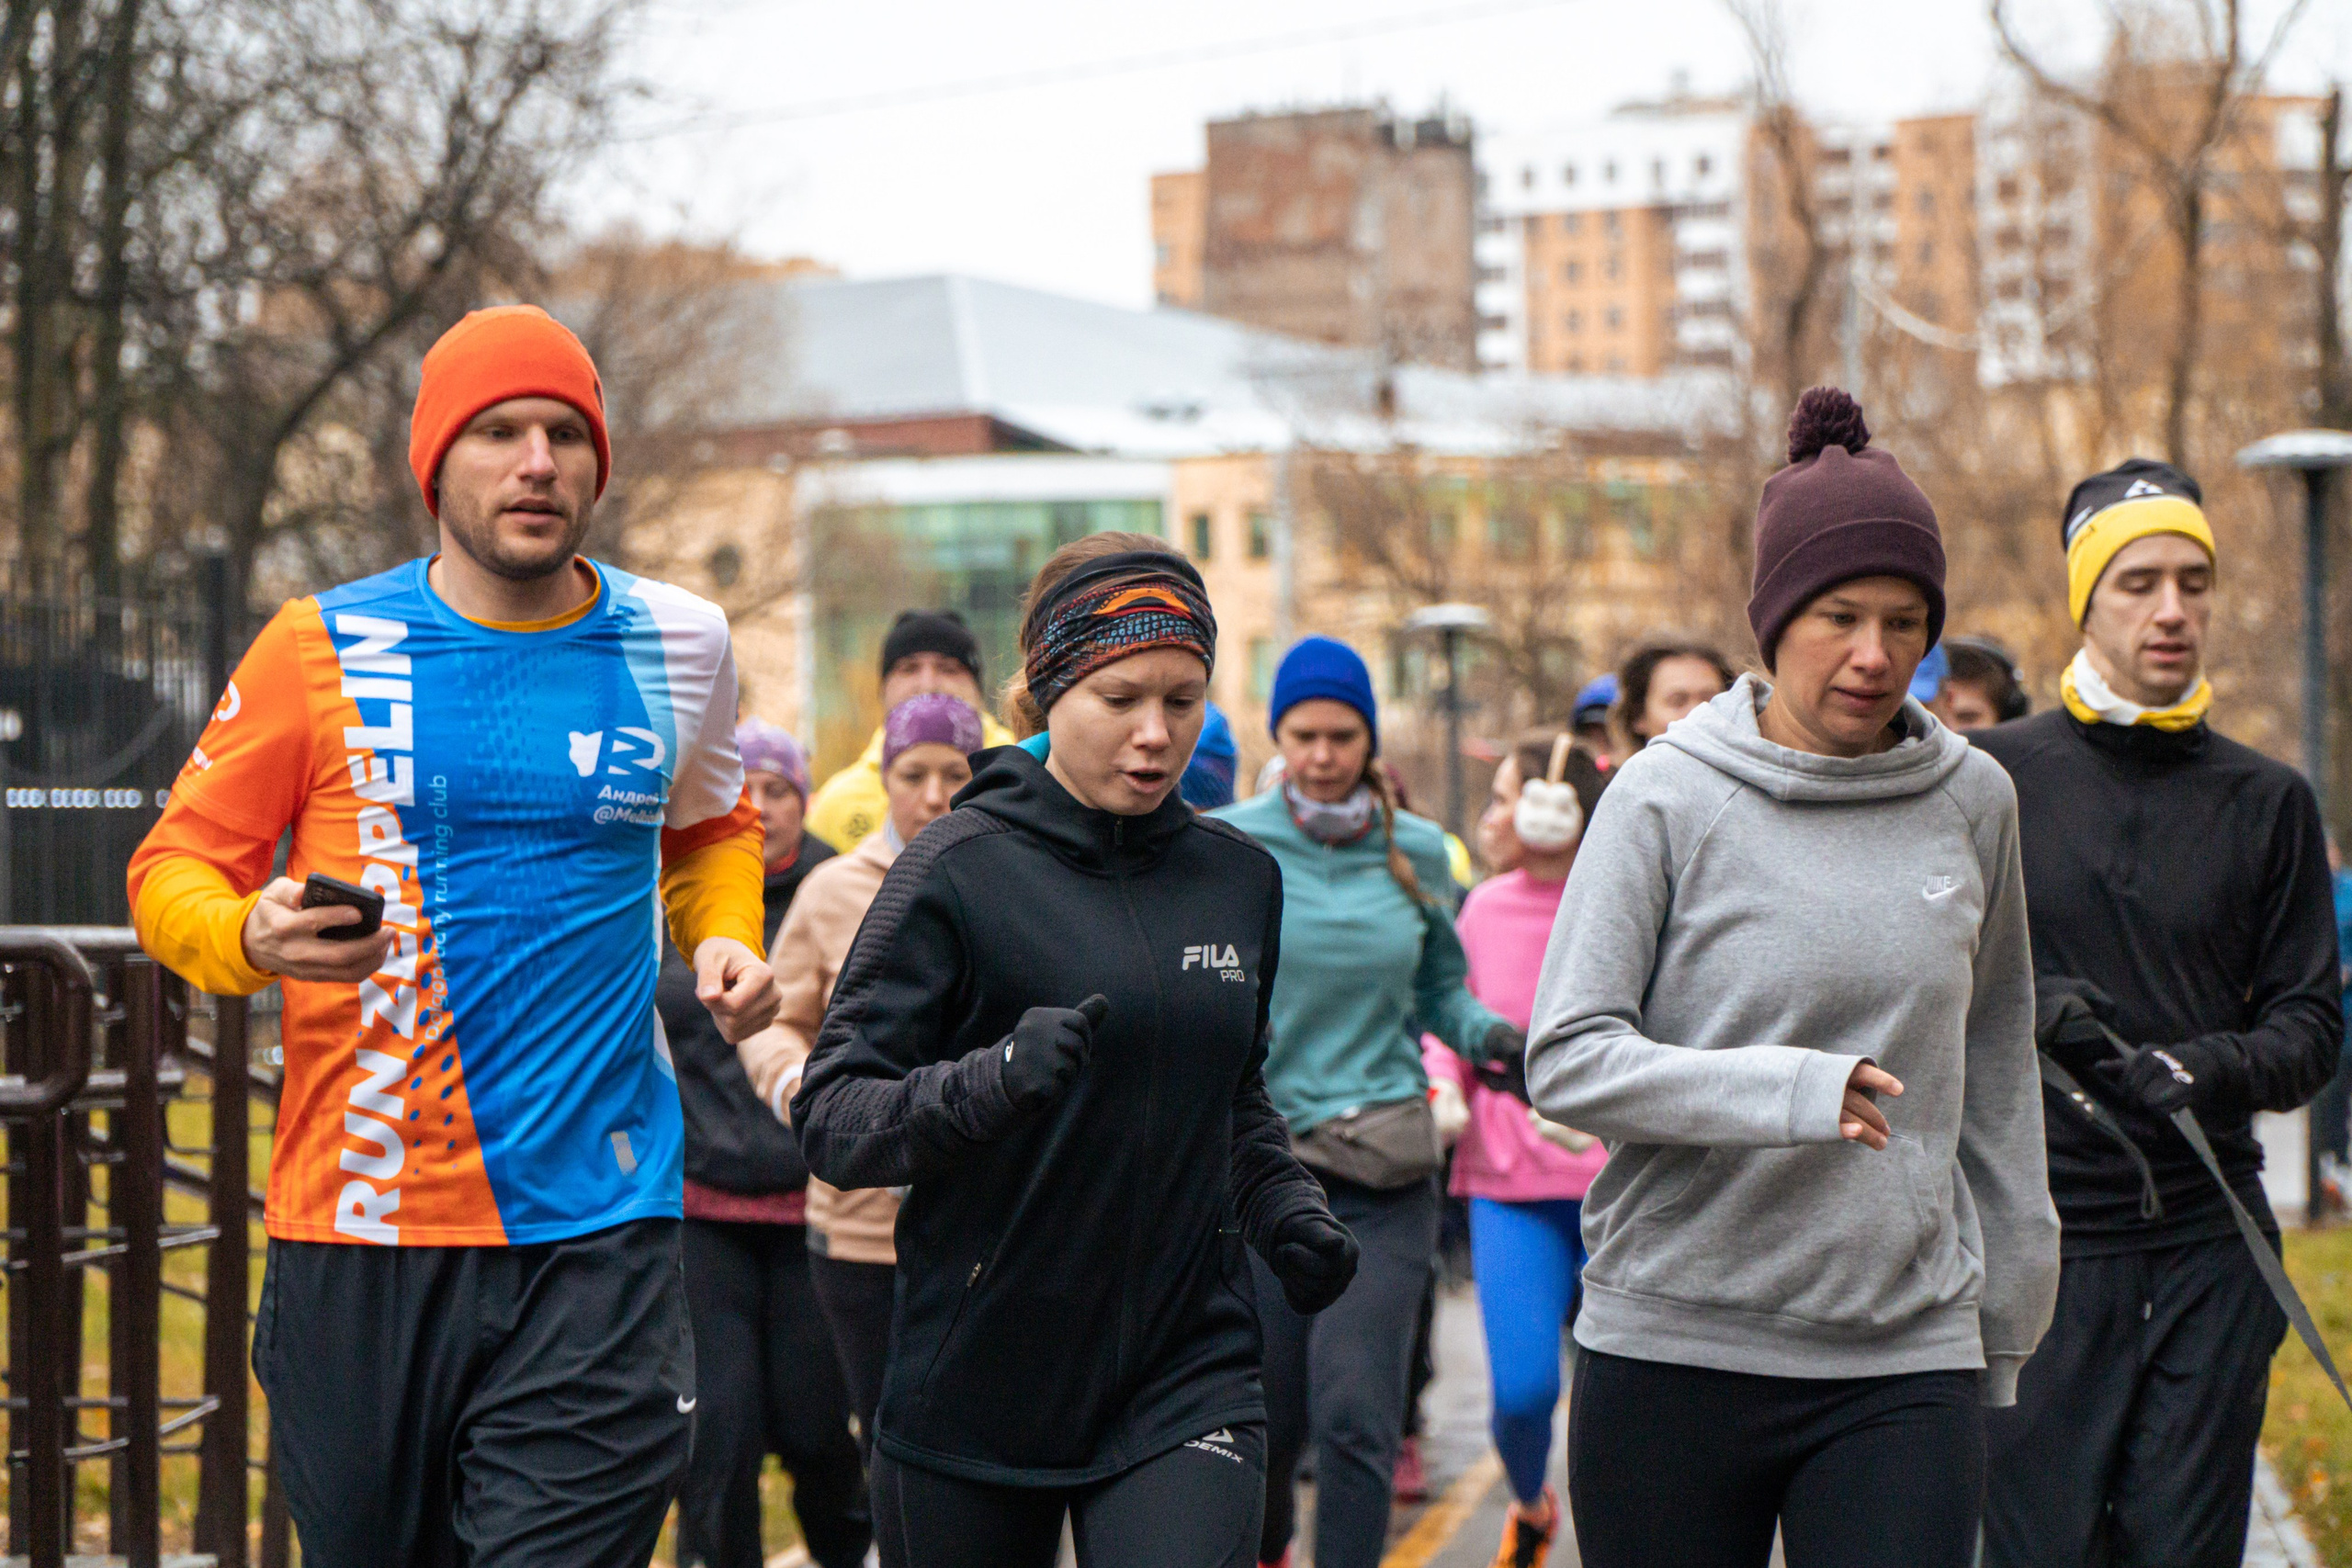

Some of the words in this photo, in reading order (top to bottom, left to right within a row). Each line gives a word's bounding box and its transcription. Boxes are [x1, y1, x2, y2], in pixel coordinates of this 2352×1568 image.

[427, 774, 448, 819] club
[337, 615, 419, 1040] ZEPPELIN
[431, 824, 454, 902] running
[1926, 874, 1951, 891] NIKE
[1182, 943, 1239, 971] FILA
[1219, 969, 1245, 982] PRO
[334, 1048, 410, 1246] RUN
[1183, 1439, 1243, 1463] DEMIX
